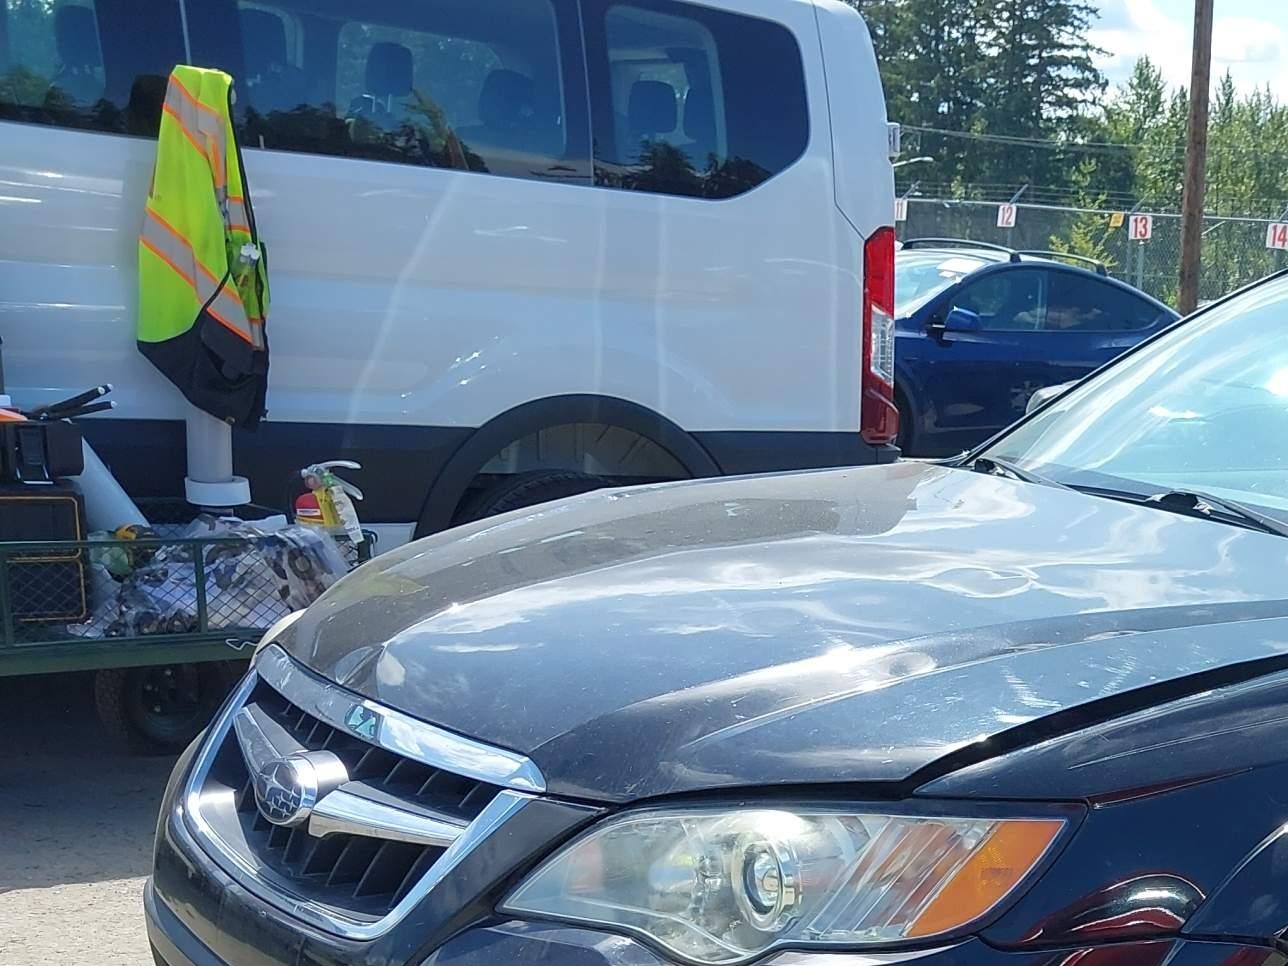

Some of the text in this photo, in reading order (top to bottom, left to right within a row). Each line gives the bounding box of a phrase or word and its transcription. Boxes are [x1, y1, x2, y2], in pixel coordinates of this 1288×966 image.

[1001, 206, 1013, 225] 12
[1133, 216, 1148, 238] 13
[1271, 224, 1288, 248] 14
